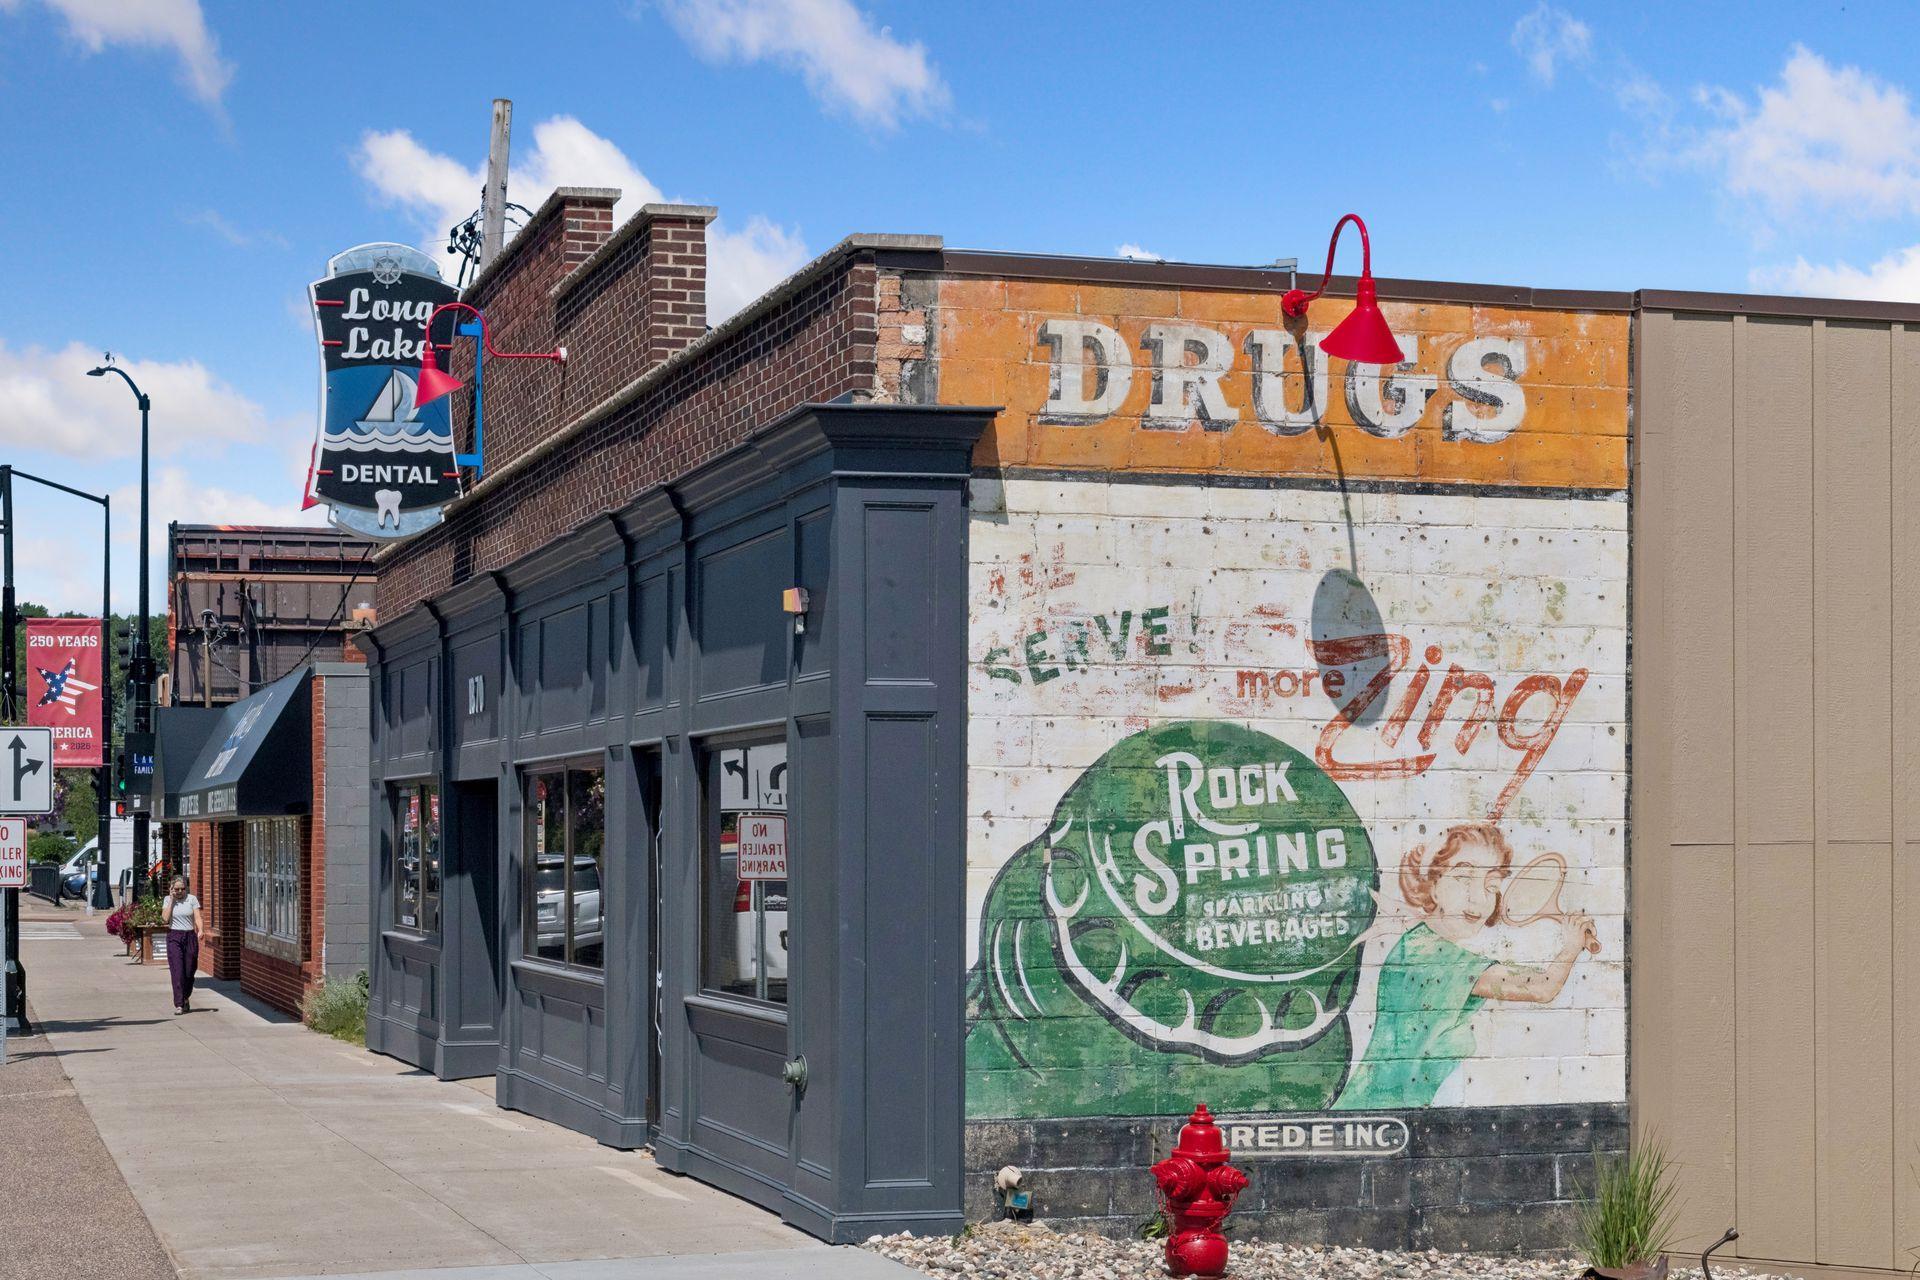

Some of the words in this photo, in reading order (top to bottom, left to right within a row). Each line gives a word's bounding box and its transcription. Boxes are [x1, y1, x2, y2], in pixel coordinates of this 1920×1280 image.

[341, 287, 434, 329] Long
[341, 326, 434, 361] Lake
[1036, 318, 1527, 444] DRUGS
[341, 464, 439, 485] DENTAL
[29, 635, 54, 647] 250
[57, 635, 98, 647] YEARS
[51, 727, 93, 738] ERICA
[1236, 668, 1346, 699] more
[1304, 633, 1590, 825] Zing
[133, 753, 154, 764] LAK
[1155, 751, 1299, 840] ROCK
[0, 865, 22, 879] KING
[1133, 819, 1347, 916] SPRING
[1195, 911, 1350, 951] BEVERAGES
